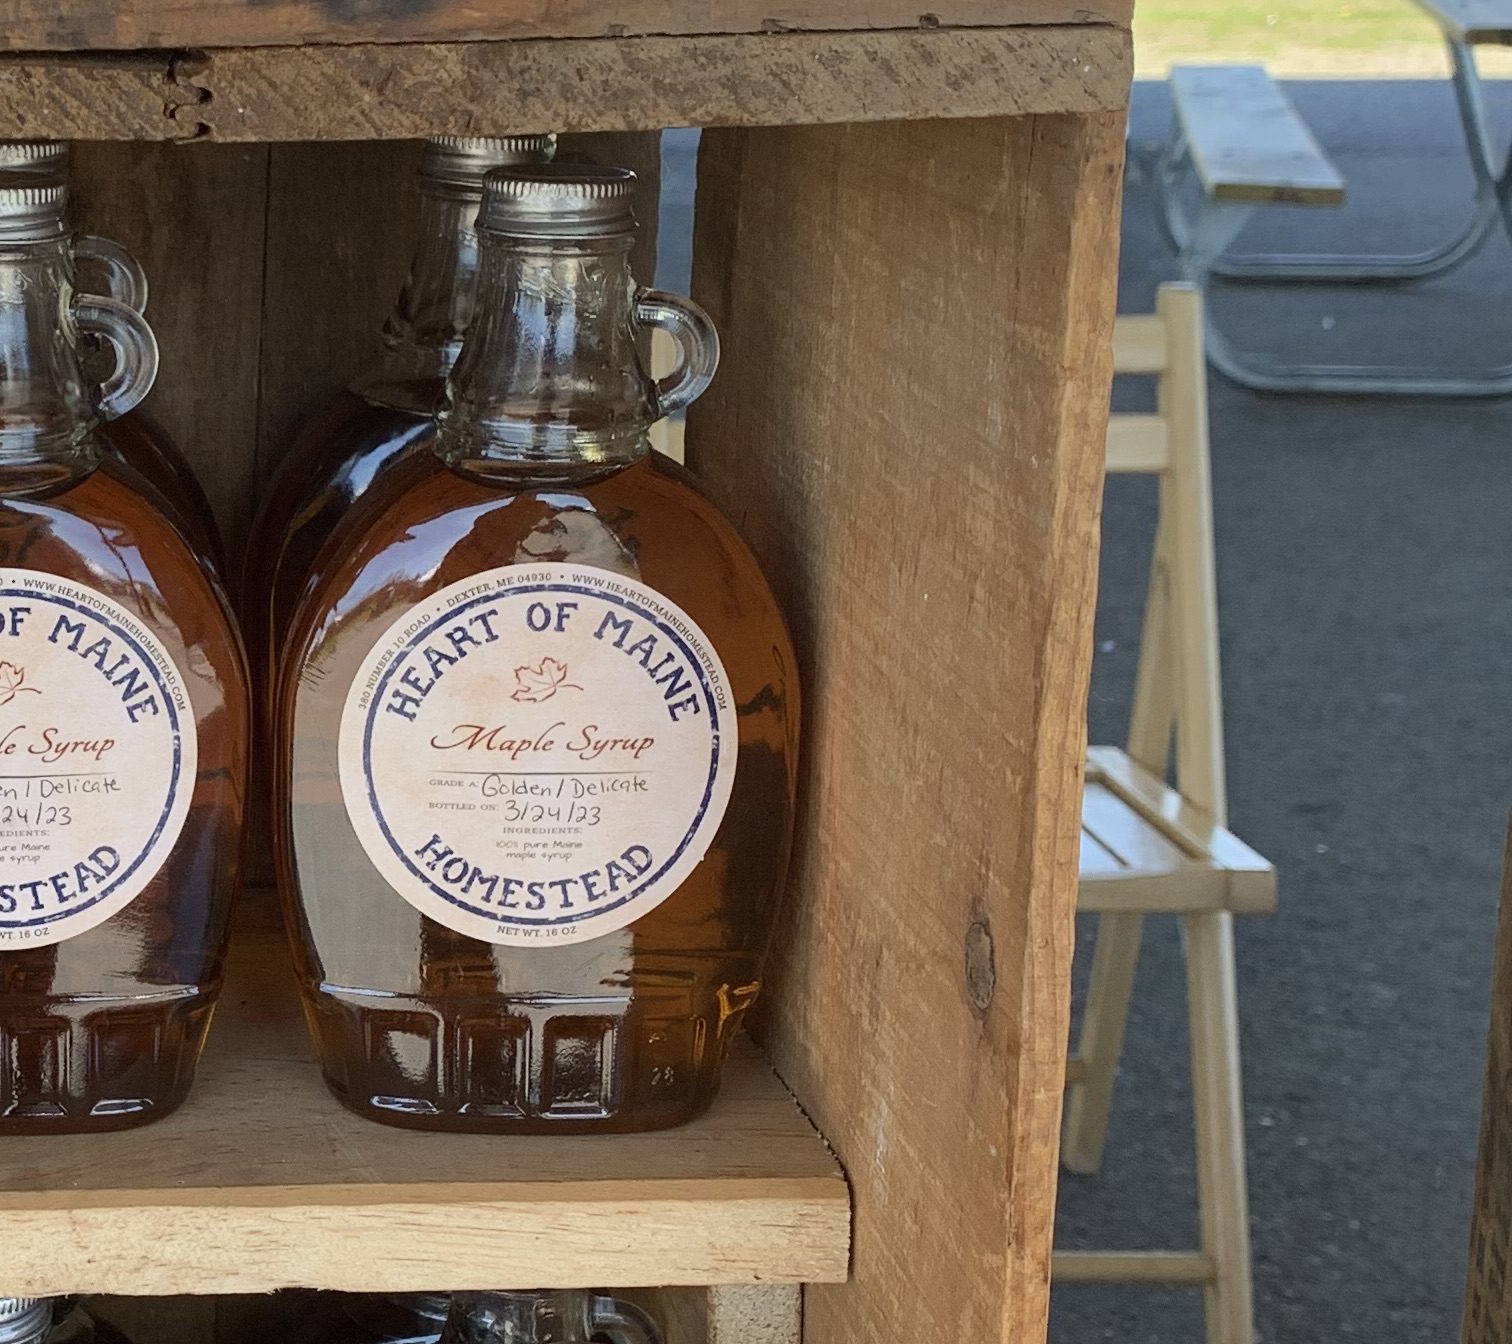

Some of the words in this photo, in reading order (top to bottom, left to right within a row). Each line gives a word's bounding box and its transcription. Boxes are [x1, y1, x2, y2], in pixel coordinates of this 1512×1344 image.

[24, 579, 186, 710] WWW.HEARTOFMAINEHOMESTEAD.COM
[366, 650, 395, 690] NUMBER
[393, 637, 405, 649] 10
[405, 614, 431, 638] ROAD
[496, 577, 514, 587] ME
[518, 573, 551, 583] 04930
[573, 574, 727, 710] WWW.HEARTOFMAINEHOMESTEAD.COM
[48, 614, 159, 723] MAINE
[386, 609, 499, 722] HEART
[527, 602, 579, 632] OF
[593, 611, 700, 722] MAINE
[28, 728, 115, 763] Syrup
[431, 722, 565, 760] Maple
[567, 725, 654, 760] Syrup
[10, 855, 40, 864] syrup
[22, 843, 50, 851] Maine
[414, 834, 653, 910] HOMESTEAD
[34, 928, 50, 937] OZ
[497, 926, 519, 935] NET
[562, 926, 577, 936] OZ
